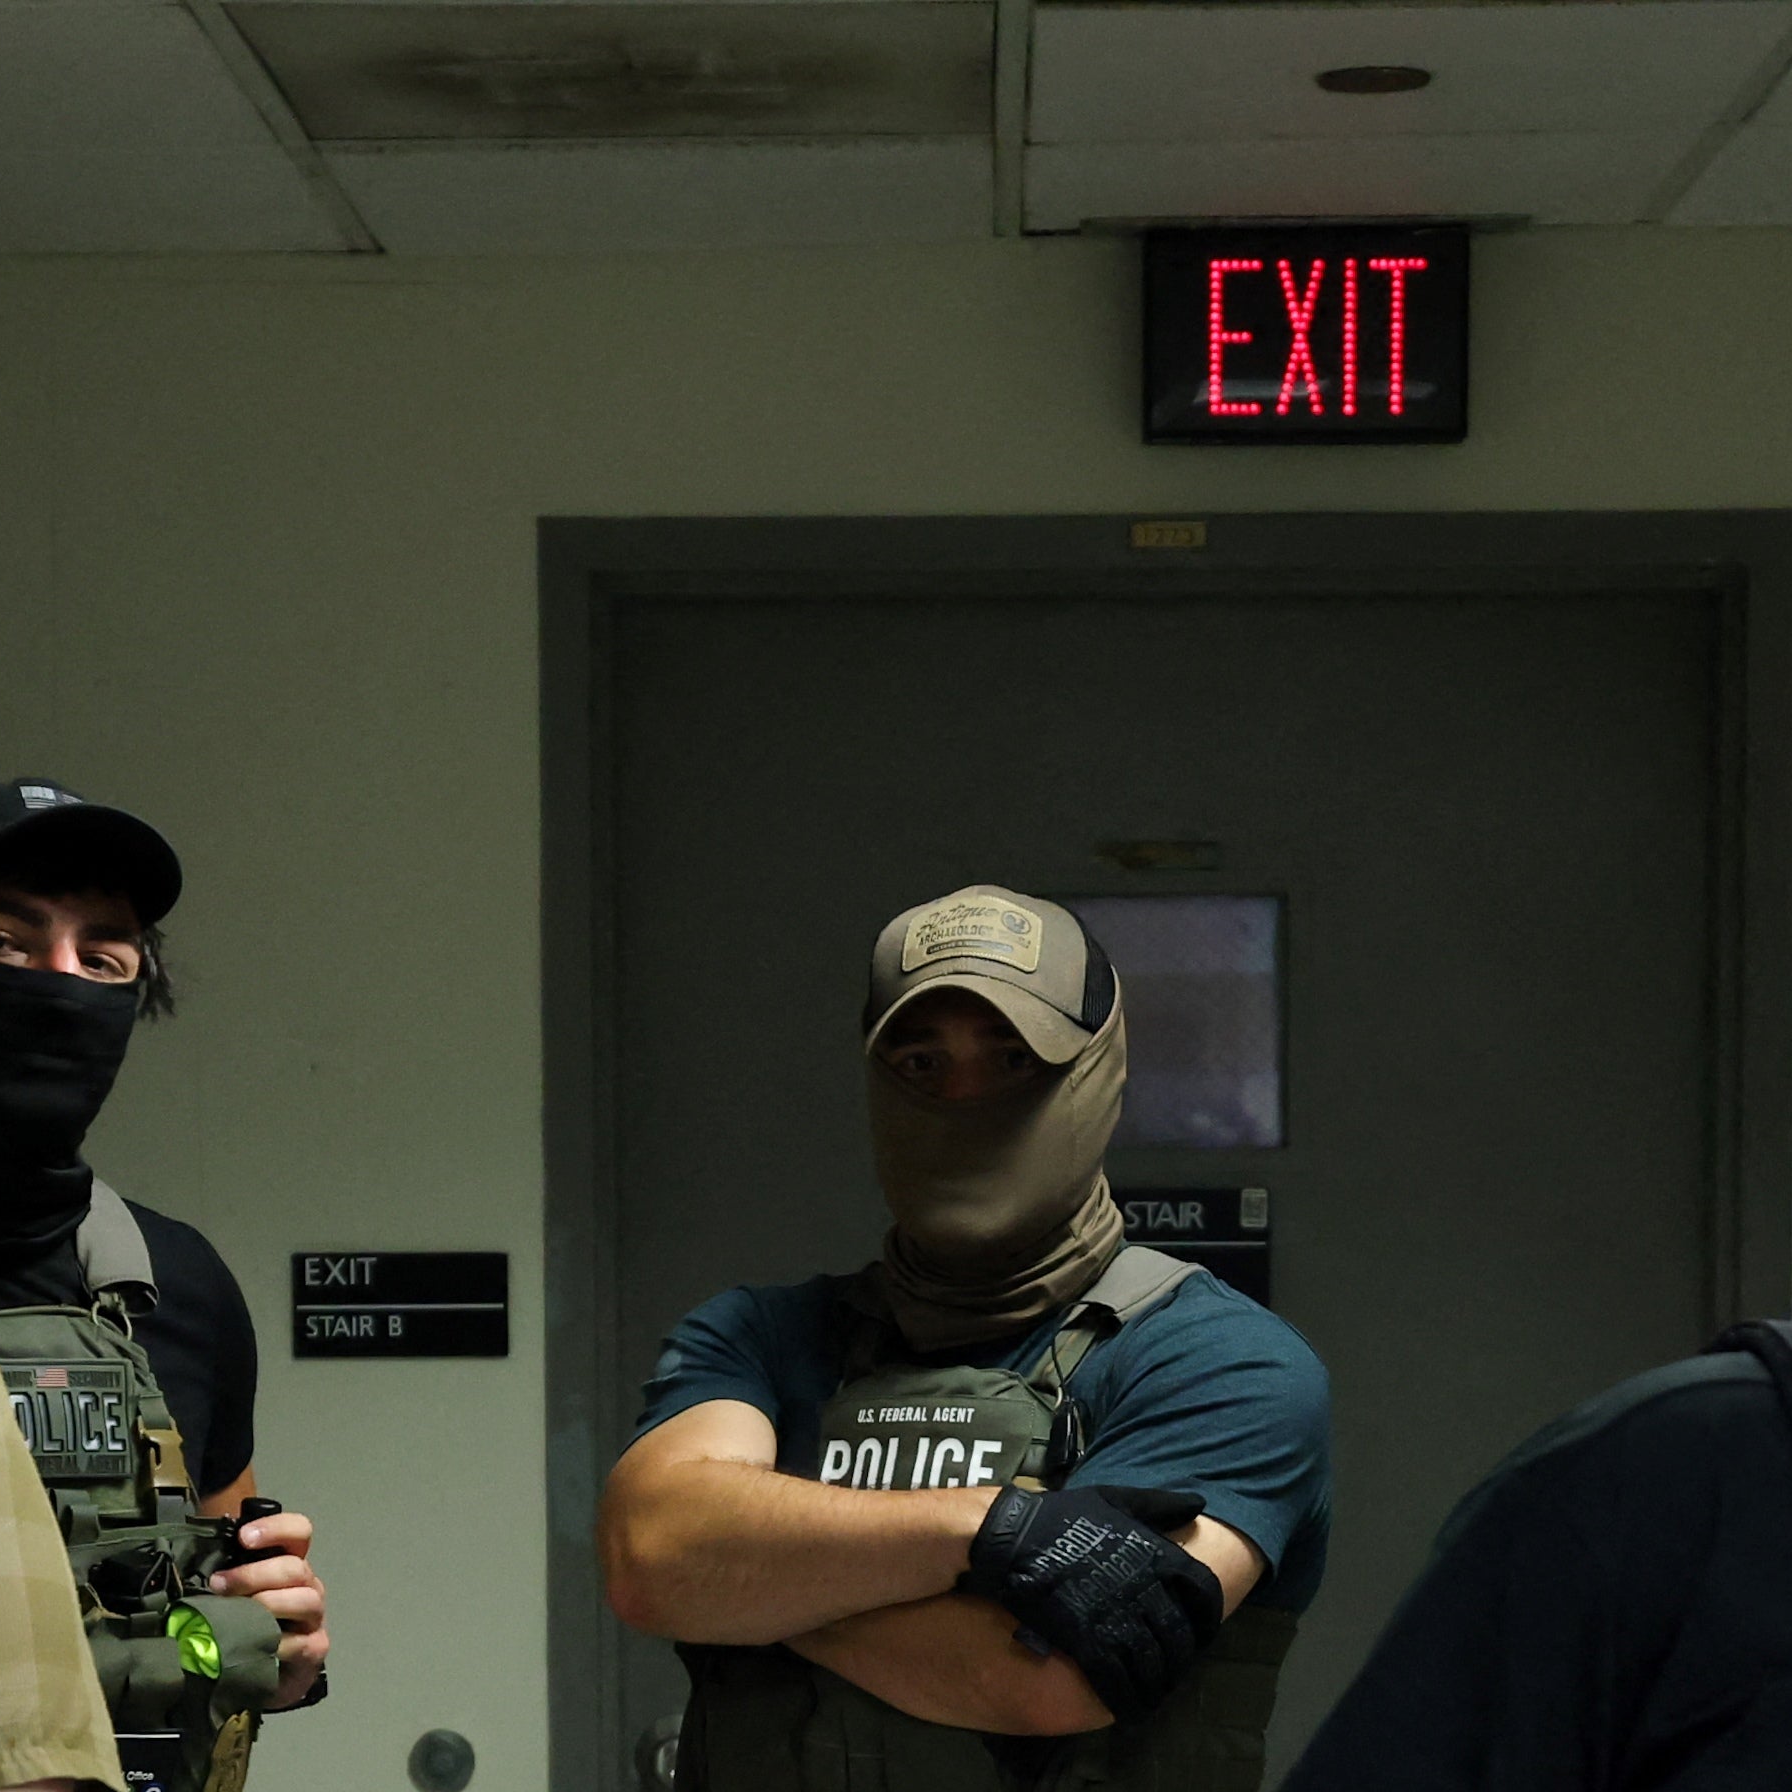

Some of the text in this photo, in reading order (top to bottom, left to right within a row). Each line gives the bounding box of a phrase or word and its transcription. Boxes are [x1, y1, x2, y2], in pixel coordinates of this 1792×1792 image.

[1208, 257, 1428, 418] EXIT
[1124, 1200, 1205, 1231] STAIR
[304, 1257, 377, 1287] EXIT
[305, 1314, 403, 1339] STAIR B
[8, 1391, 126, 1453] OLICE
[857, 1406, 976, 1424] U.S. FEDERAL AGENT
[820, 1436, 1003, 1491] POLICE
